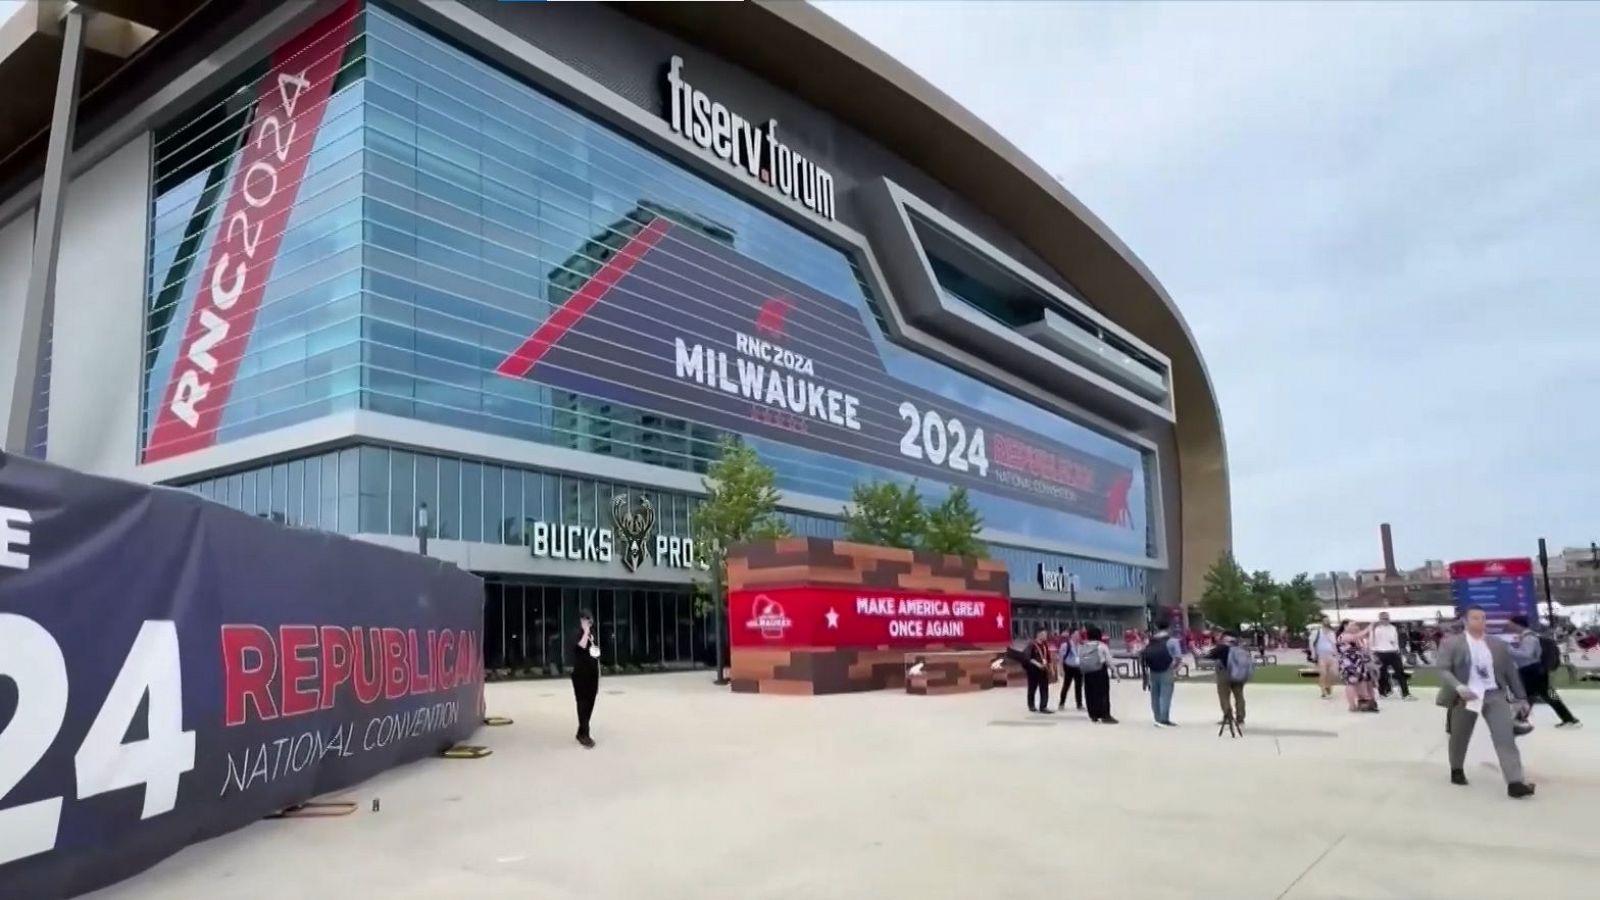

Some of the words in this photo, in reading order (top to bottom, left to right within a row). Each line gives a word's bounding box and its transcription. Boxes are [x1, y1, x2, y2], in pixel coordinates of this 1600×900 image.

[668, 55, 836, 221] fiserv.forum
[170, 71, 310, 429] RNC2024
[675, 337, 862, 431] MILWAUKEE
[899, 402, 989, 477] 2024
[533, 521, 612, 562] BUCKS
[656, 535, 694, 568] PRO
[856, 597, 896, 615] MAKE
[898, 598, 950, 617] AMERICA
[952, 600, 985, 617] GREAT
[889, 619, 923, 638] ONCE
[926, 620, 964, 638] AGAIN!
[220, 723, 355, 797] NATIONAL
[363, 700, 460, 752] CONVENTION
